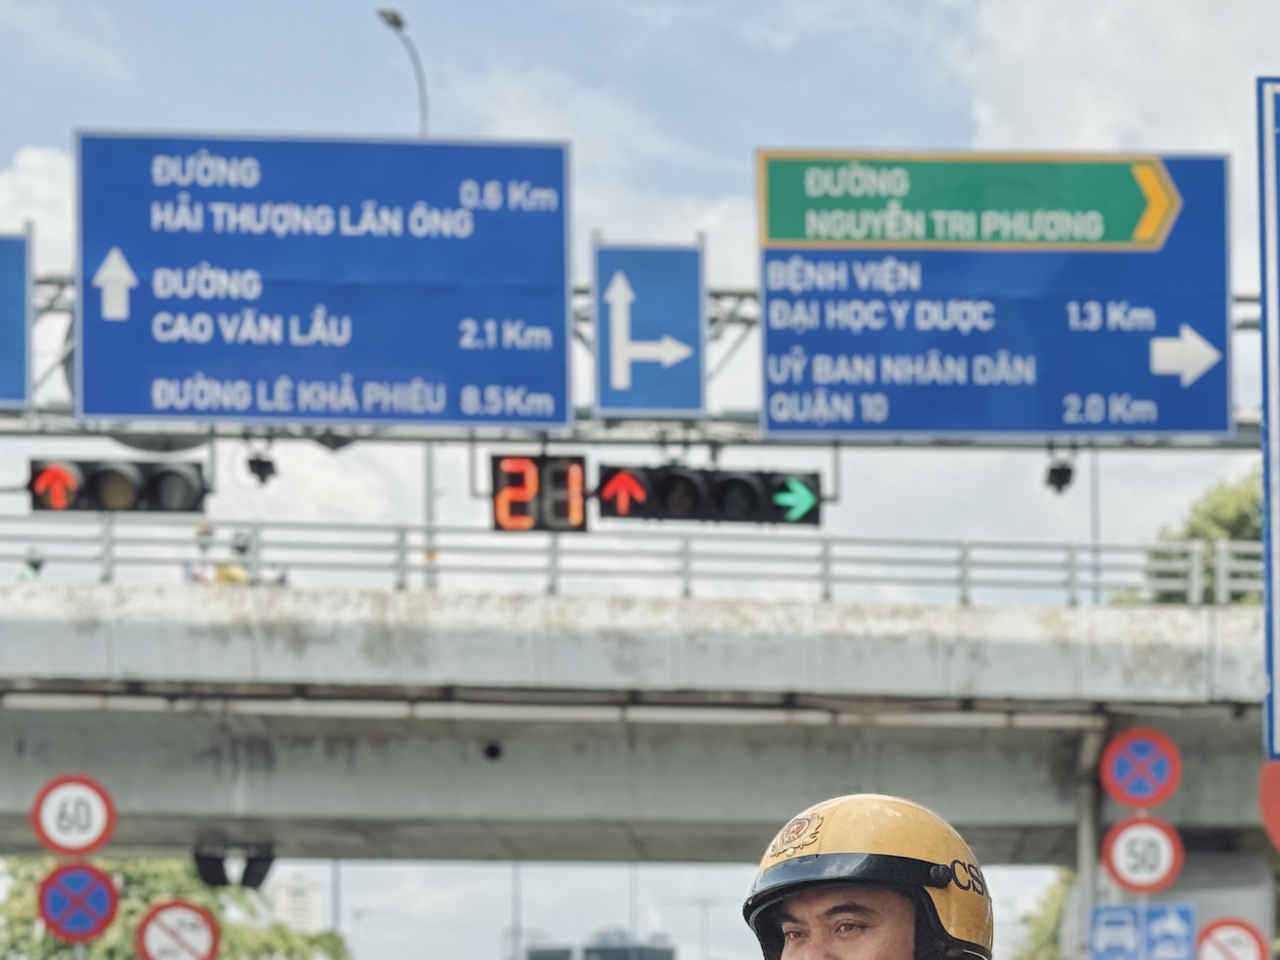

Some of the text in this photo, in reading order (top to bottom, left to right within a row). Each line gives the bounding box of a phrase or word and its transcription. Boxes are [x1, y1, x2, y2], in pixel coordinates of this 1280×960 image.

[151, 148, 261, 188] ĐƯỜNG
[804, 160, 910, 198] ĐƯỜNG
[459, 179, 558, 212] 0.6 Km
[151, 191, 204, 232] HẢI
[208, 200, 336, 239] THƯỢNG
[408, 201, 474, 239] ÔNG
[805, 199, 1104, 242] NGUYỄN TRI PHƯƠNG
[153, 261, 263, 300] ĐƯỜNG
[767, 253, 922, 297] BỆNH VIỆN
[152, 311, 214, 344] CAO
[217, 307, 284, 345] VĂN
[458, 318, 553, 350] 2.1 Km
[769, 297, 996, 336] ĐẠI HỌC Y DƯỢC
[1065, 300, 1157, 332] 1.3 Km
[812, 353, 875, 385] BAN
[881, 348, 967, 386] NHÂN
[972, 349, 1037, 386] DÂN
[151, 371, 253, 411] ĐƯỜNG
[256, 375, 293, 412] LÊ
[769, 387, 889, 426] QUẬN 10
[1062, 393, 1158, 424] 2.0 Km
[495, 457, 584, 531] 21
[56, 797, 92, 835] 60
[1125, 837, 1163, 874] 50
[951, 859, 988, 896] CS
